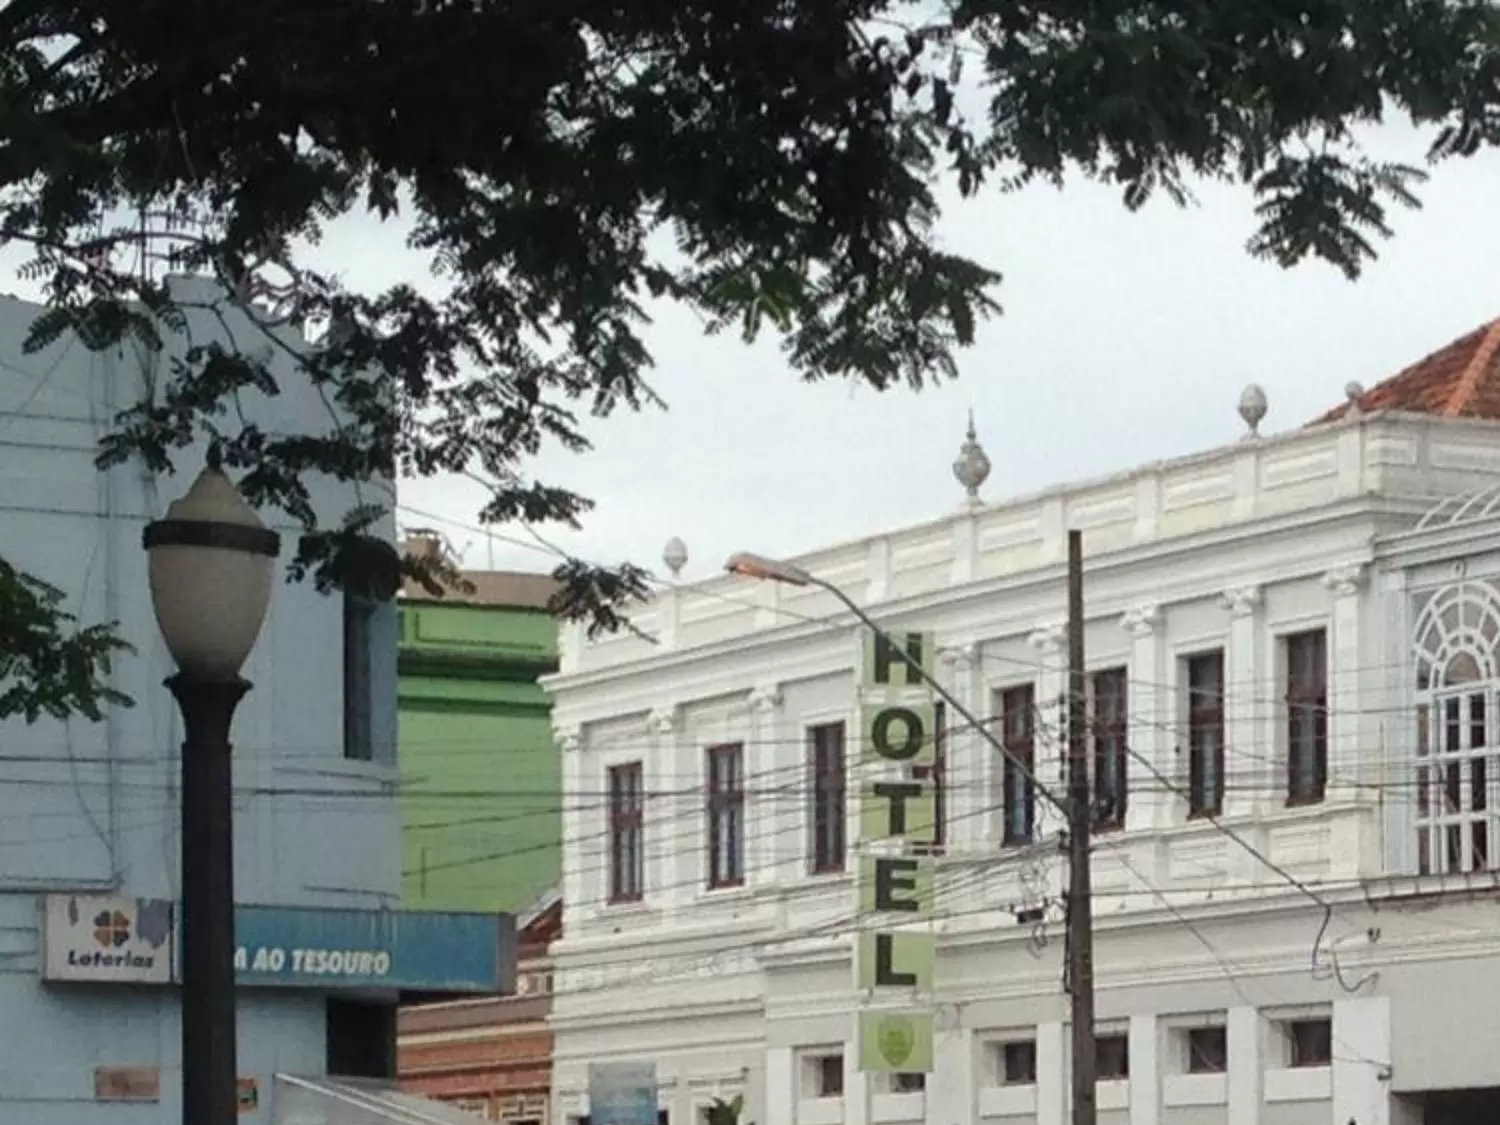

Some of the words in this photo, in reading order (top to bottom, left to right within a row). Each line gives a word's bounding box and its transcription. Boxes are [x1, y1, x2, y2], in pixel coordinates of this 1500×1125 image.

[871, 633, 923, 986] HOTEL
[66, 949, 155, 969] Loterias
[252, 948, 285, 972] AO
[292, 949, 390, 975] TESOURO
